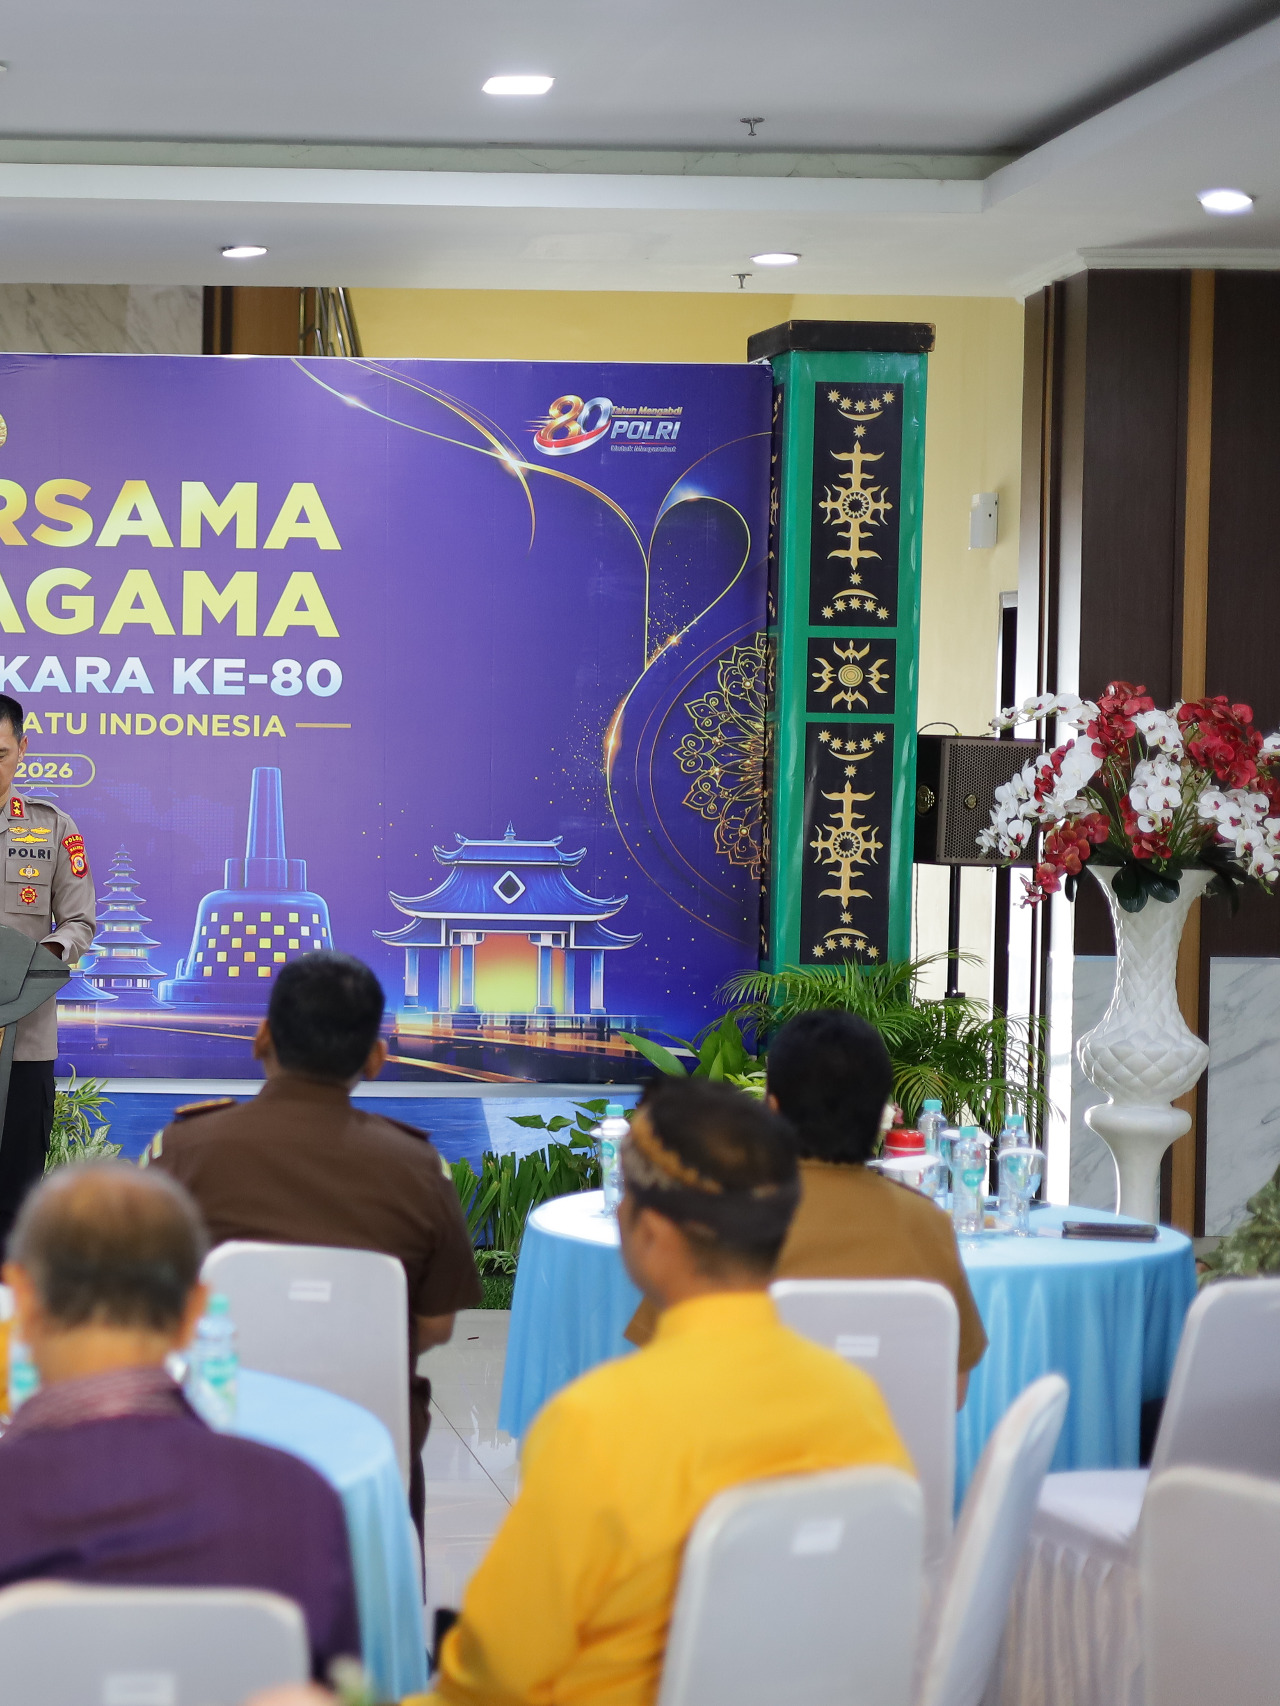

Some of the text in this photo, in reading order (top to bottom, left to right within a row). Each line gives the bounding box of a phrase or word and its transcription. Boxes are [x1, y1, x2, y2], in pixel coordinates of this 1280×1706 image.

[612, 405, 683, 416] Tahun Mengabdi
[535, 394, 614, 450] 80
[610, 420, 681, 440] POLRI
[172, 656, 345, 699] KE-80
[22, 711, 88, 736] ATU
[99, 712, 288, 739] INDONESIA
[14, 761, 74, 779] 2026
[64, 835, 84, 847] POLDA
[8, 847, 51, 860] POLRI
